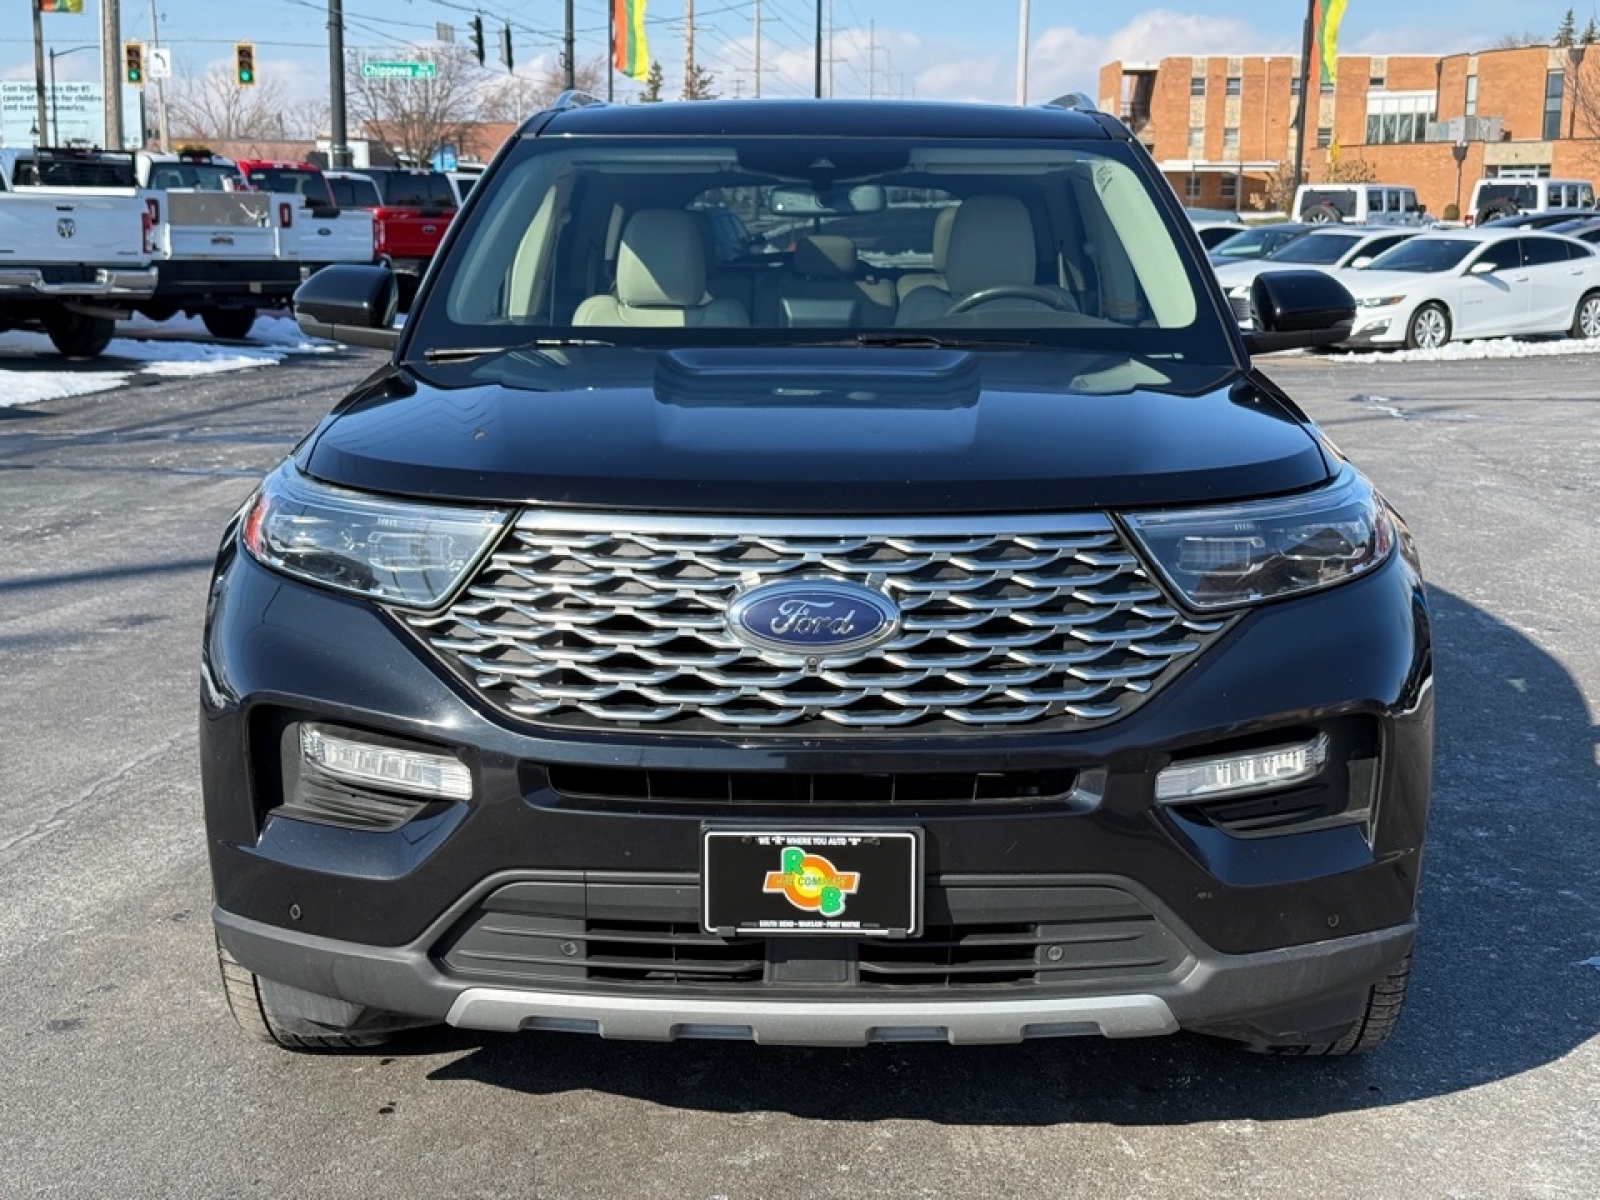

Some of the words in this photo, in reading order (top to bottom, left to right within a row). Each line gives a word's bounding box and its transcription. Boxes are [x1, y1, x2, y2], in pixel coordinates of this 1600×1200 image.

[365, 64, 413, 77] Chippewa
[26, 94, 35, 102] of
[61, 94, 72, 102] for
[65, 84, 78, 92] the
[770, 599, 856, 635] Ford
[782, 847, 806, 875] R
[820, 886, 845, 915] B
